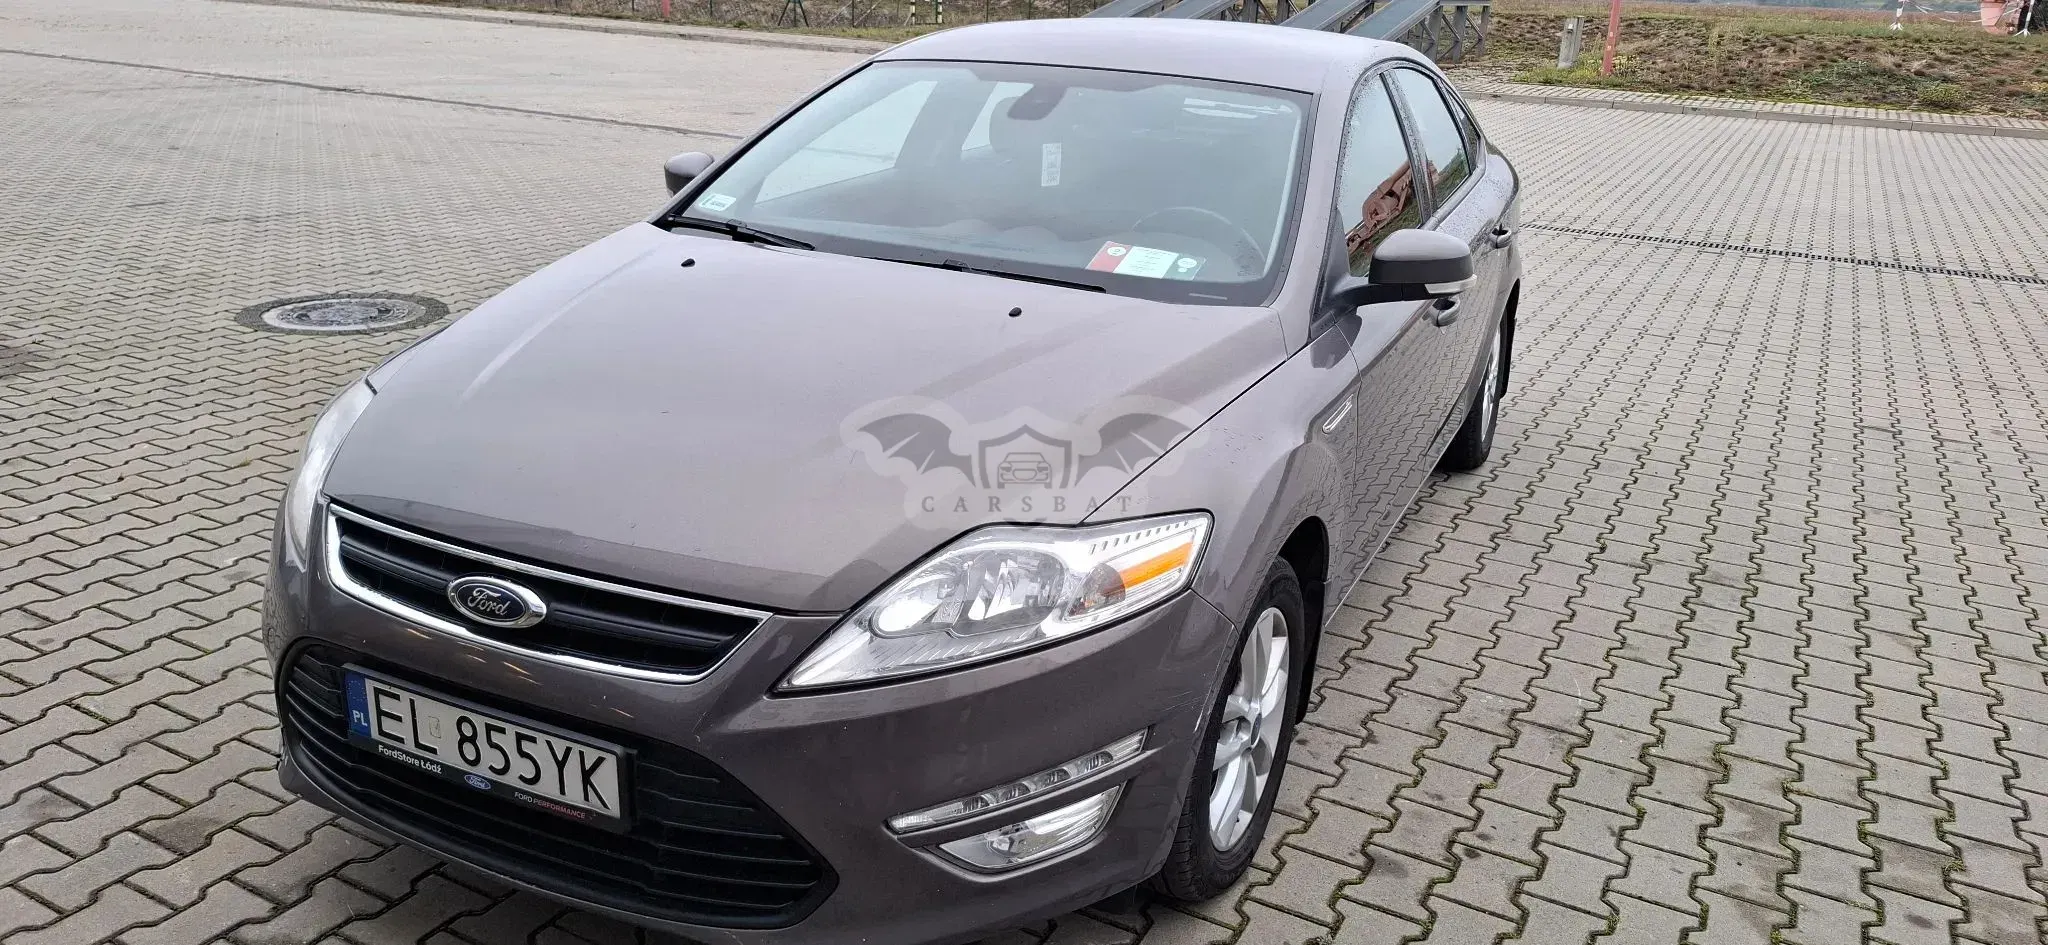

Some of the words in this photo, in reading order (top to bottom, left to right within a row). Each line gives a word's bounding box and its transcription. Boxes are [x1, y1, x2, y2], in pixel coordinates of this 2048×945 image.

[467, 587, 511, 616] Ford
[352, 709, 368, 727] PL
[373, 686, 438, 755] EL
[456, 715, 611, 810] 855YK
[378, 744, 420, 767] FordStore
[420, 759, 442, 774] Łódź
[514, 791, 533, 803] FORD
[533, 798, 586, 819] PERFORMANCE
